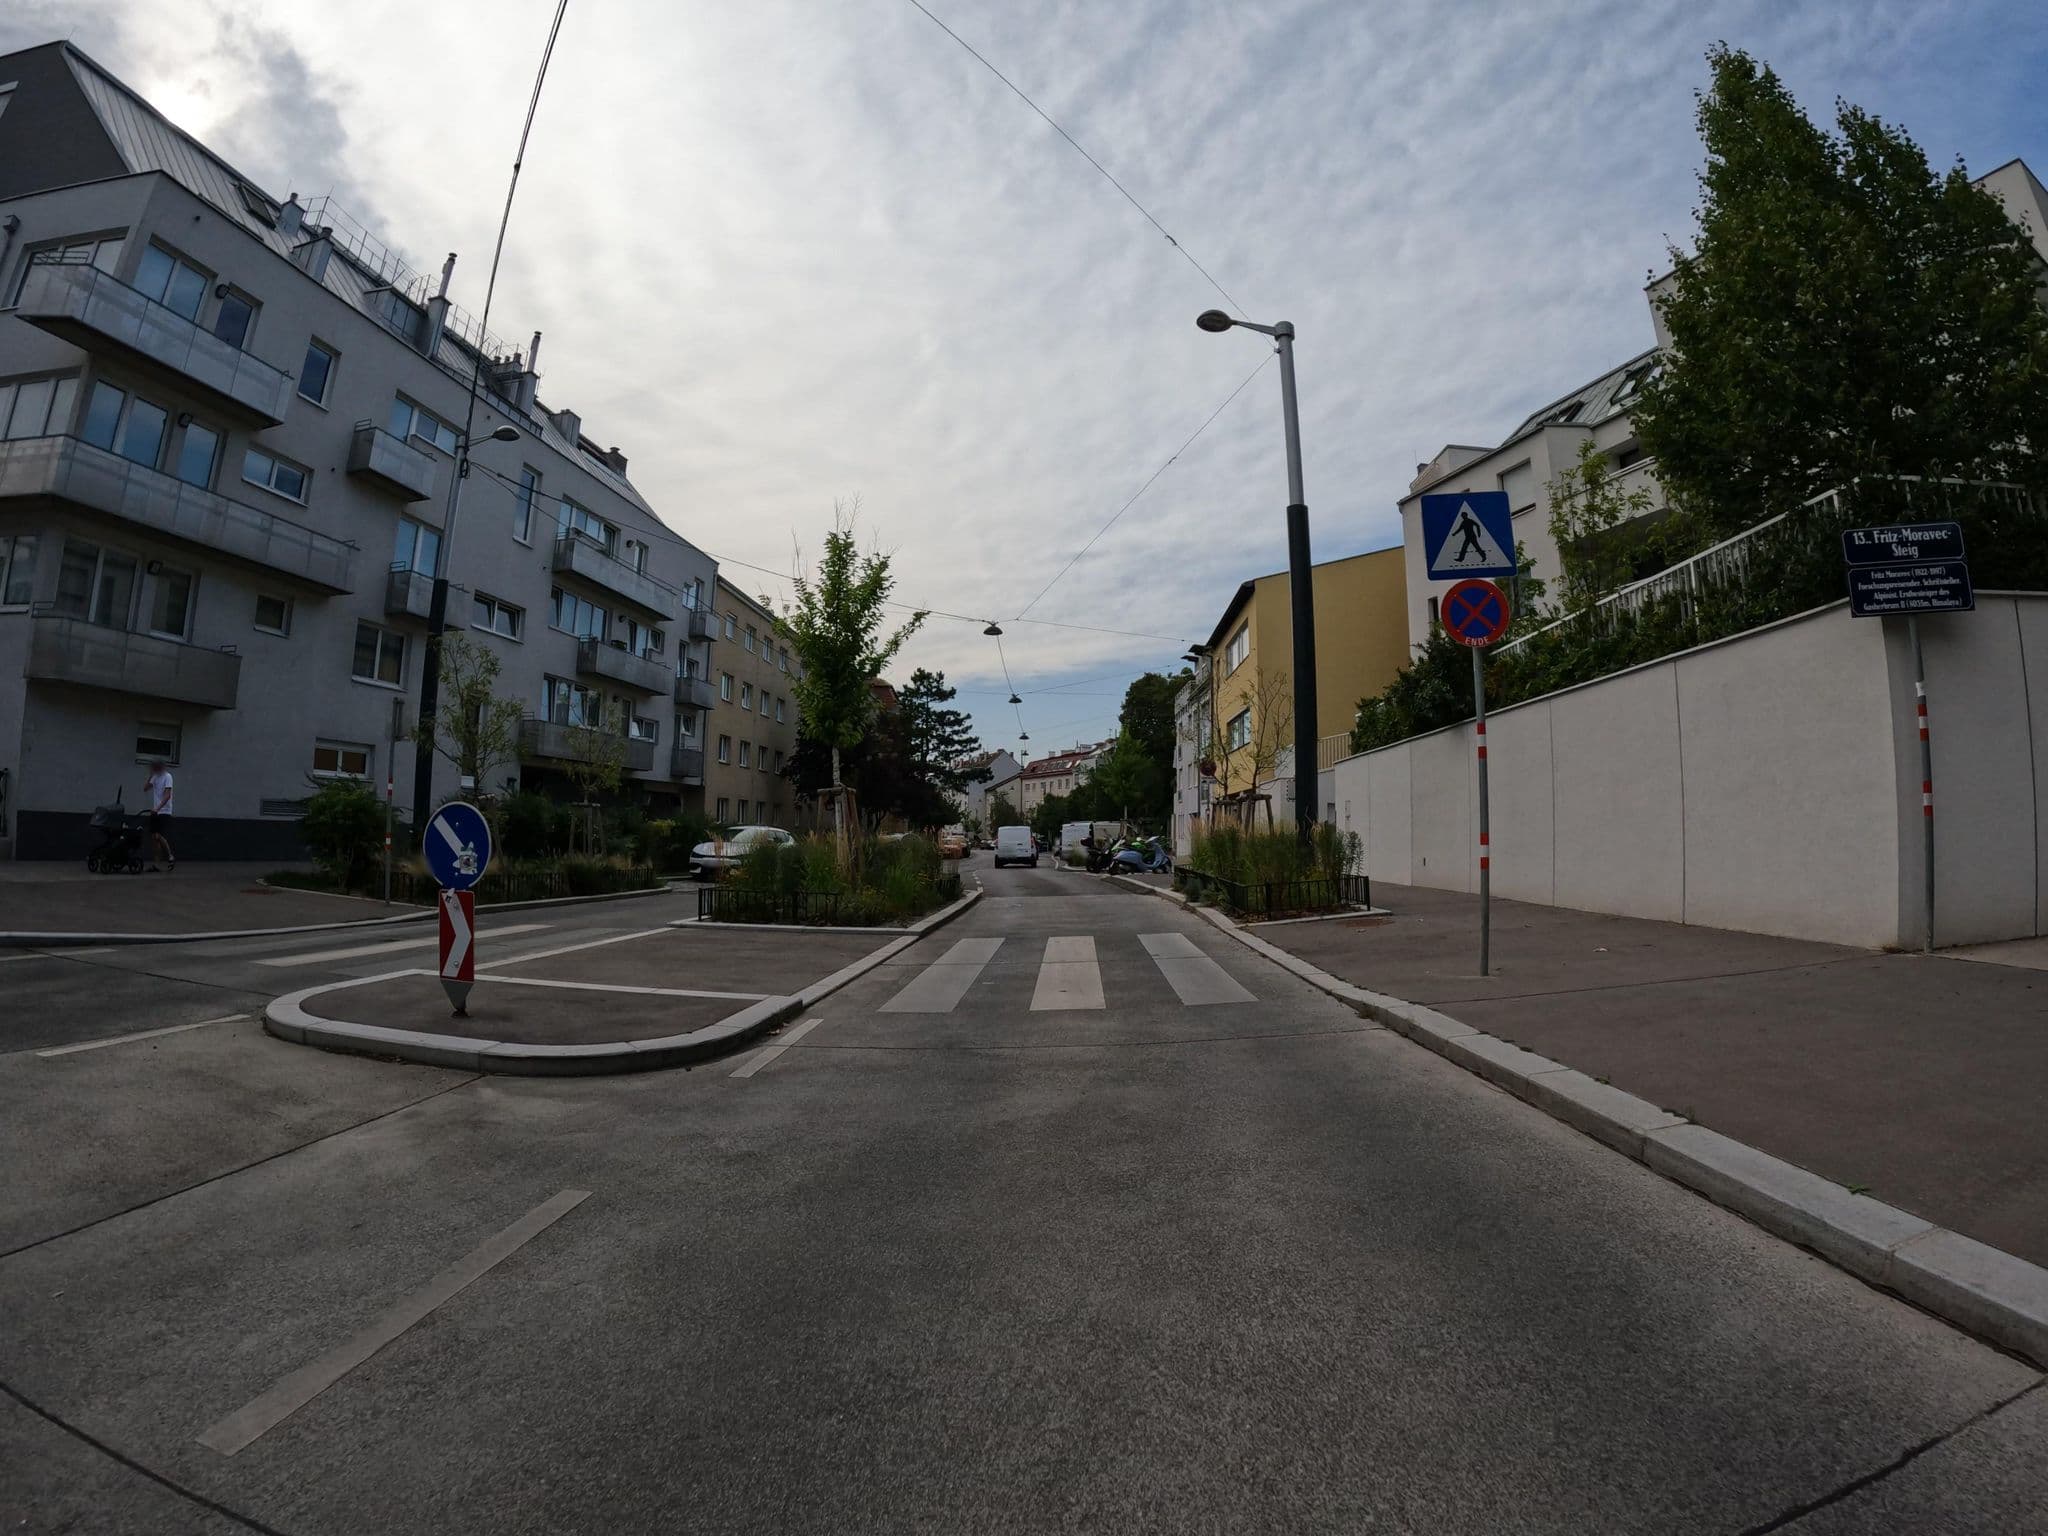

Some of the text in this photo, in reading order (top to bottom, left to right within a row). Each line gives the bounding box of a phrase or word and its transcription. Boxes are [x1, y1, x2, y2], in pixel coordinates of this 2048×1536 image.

[1873, 528, 1952, 544] Fritz-Moravec-
[1891, 544, 1919, 558] Steig
[1871, 571, 1885, 579] Fritz
[1464, 636, 1489, 646] ENDE
